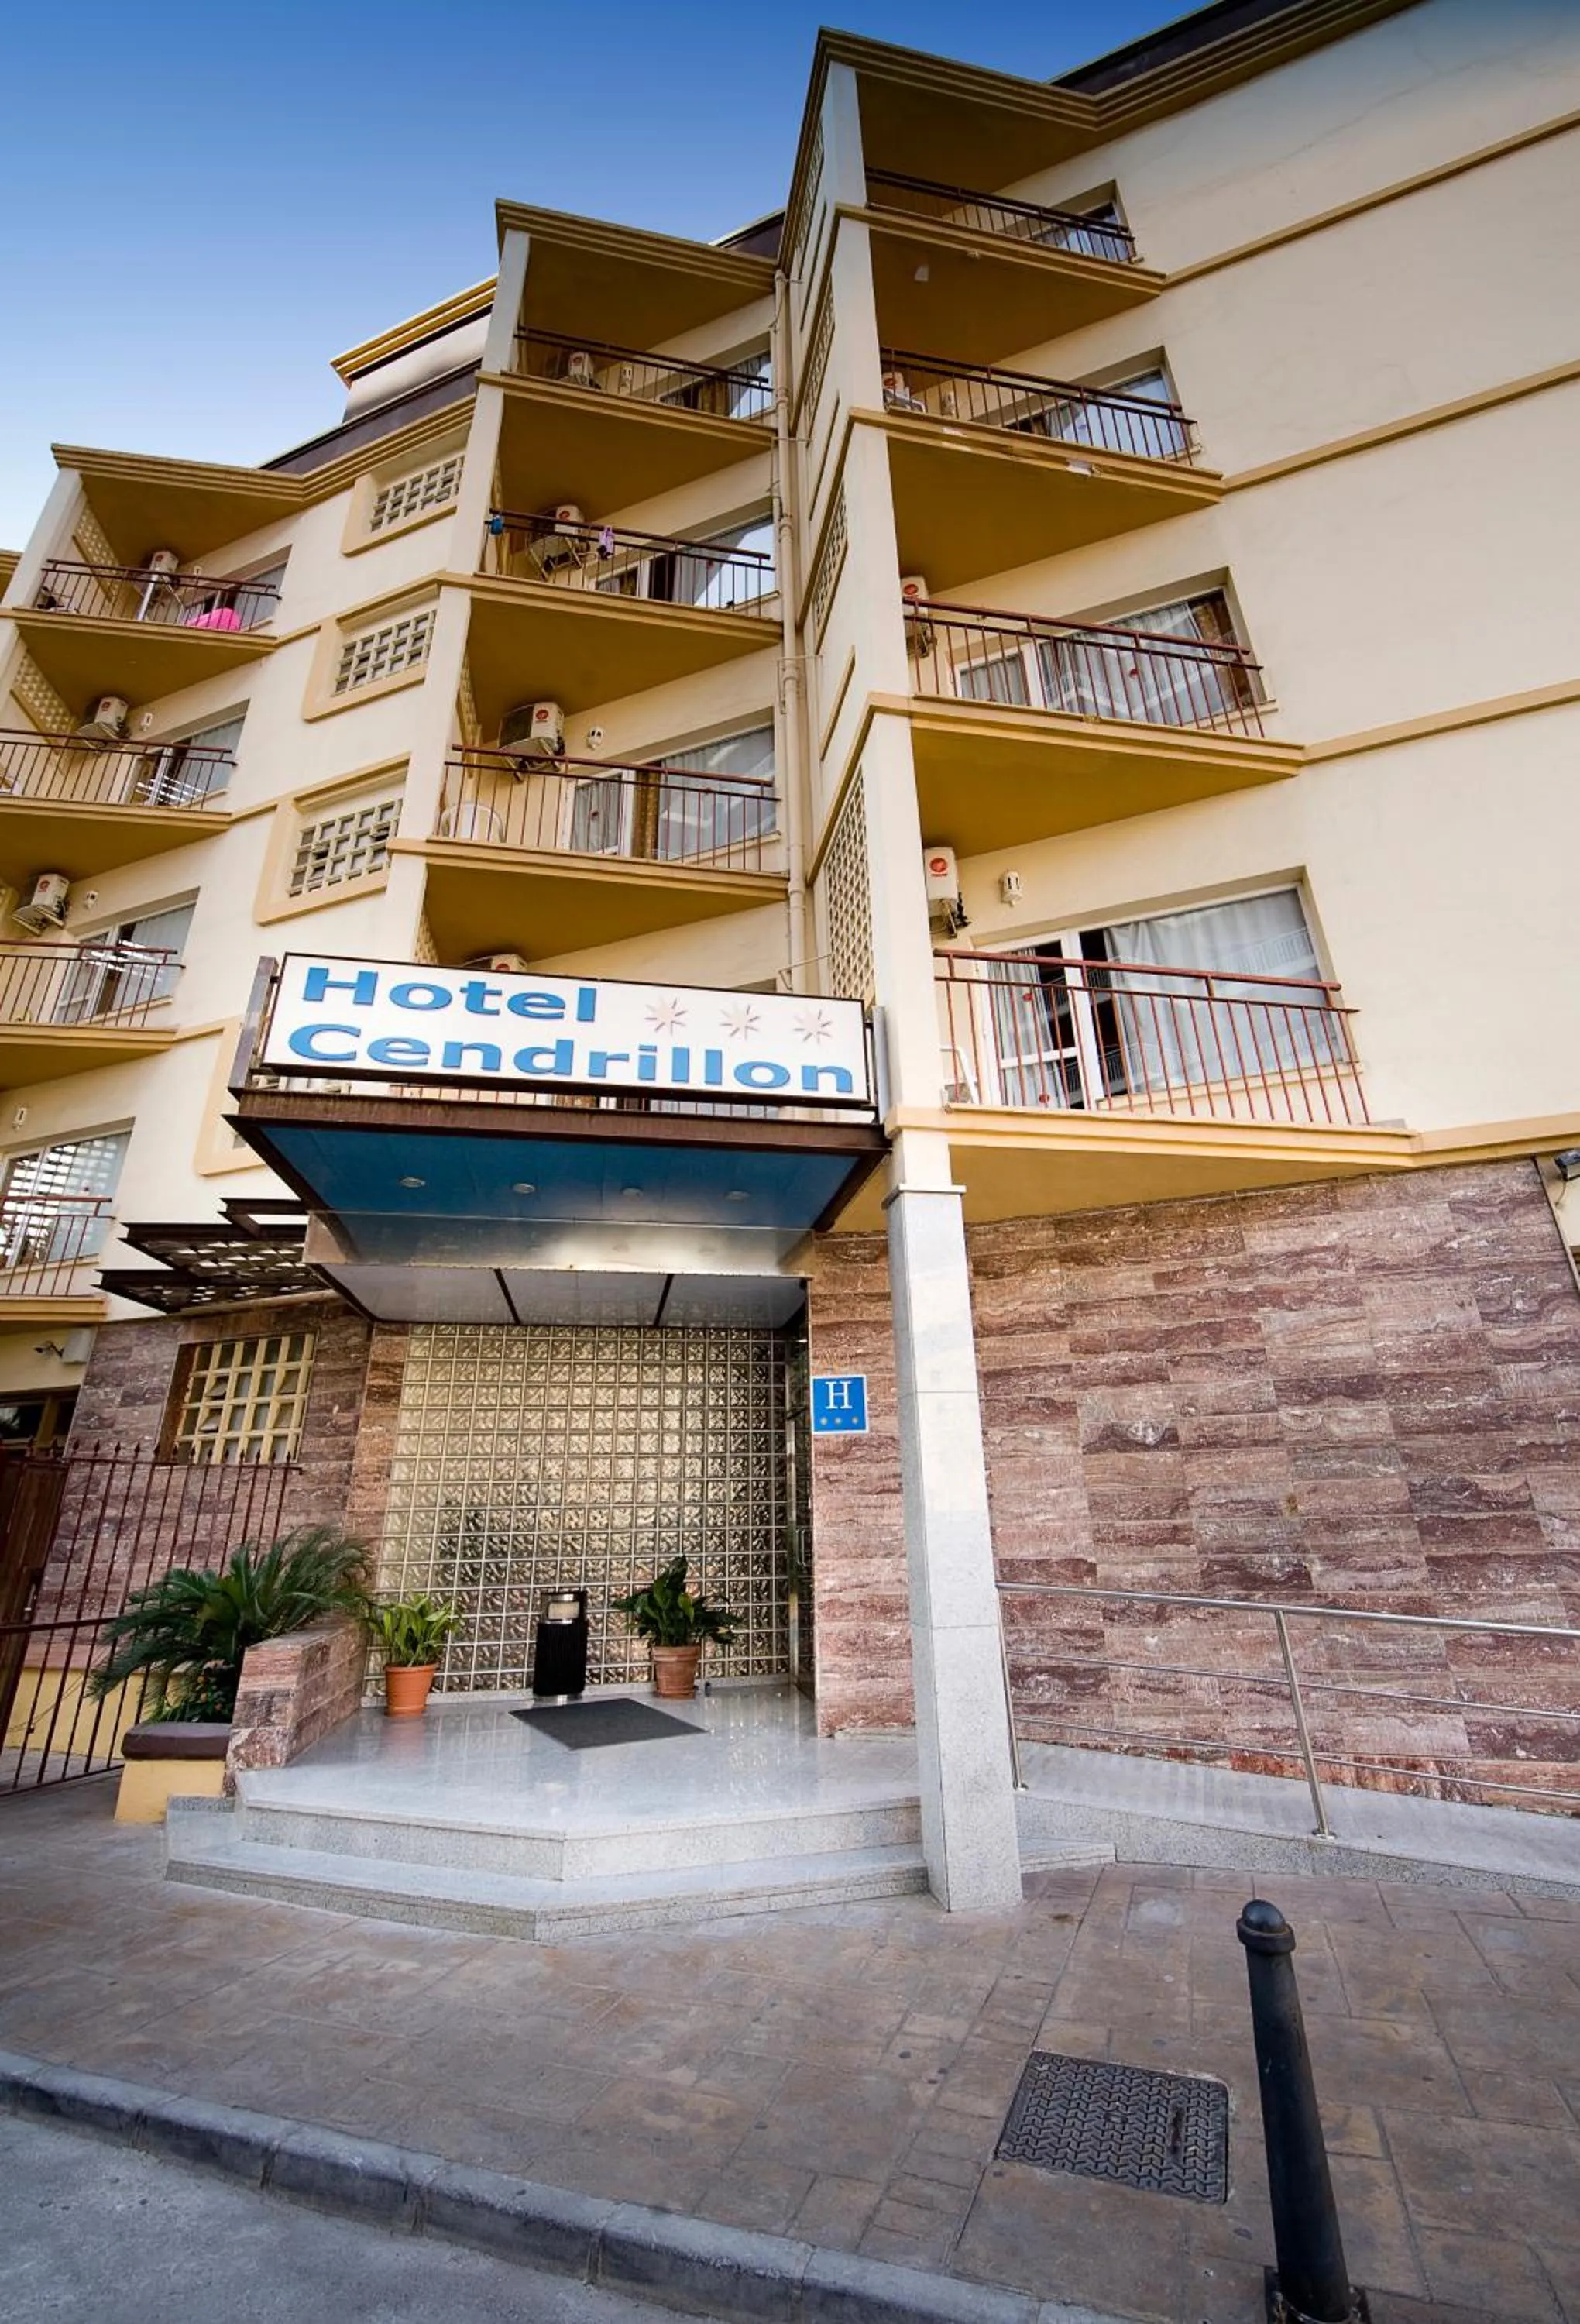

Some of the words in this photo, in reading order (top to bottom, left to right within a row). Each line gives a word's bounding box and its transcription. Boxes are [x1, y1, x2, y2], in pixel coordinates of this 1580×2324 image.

[302, 965, 597, 1023] Hotel
[287, 1023, 854, 1093] Cendrillon
[825, 1380, 853, 1409] H
